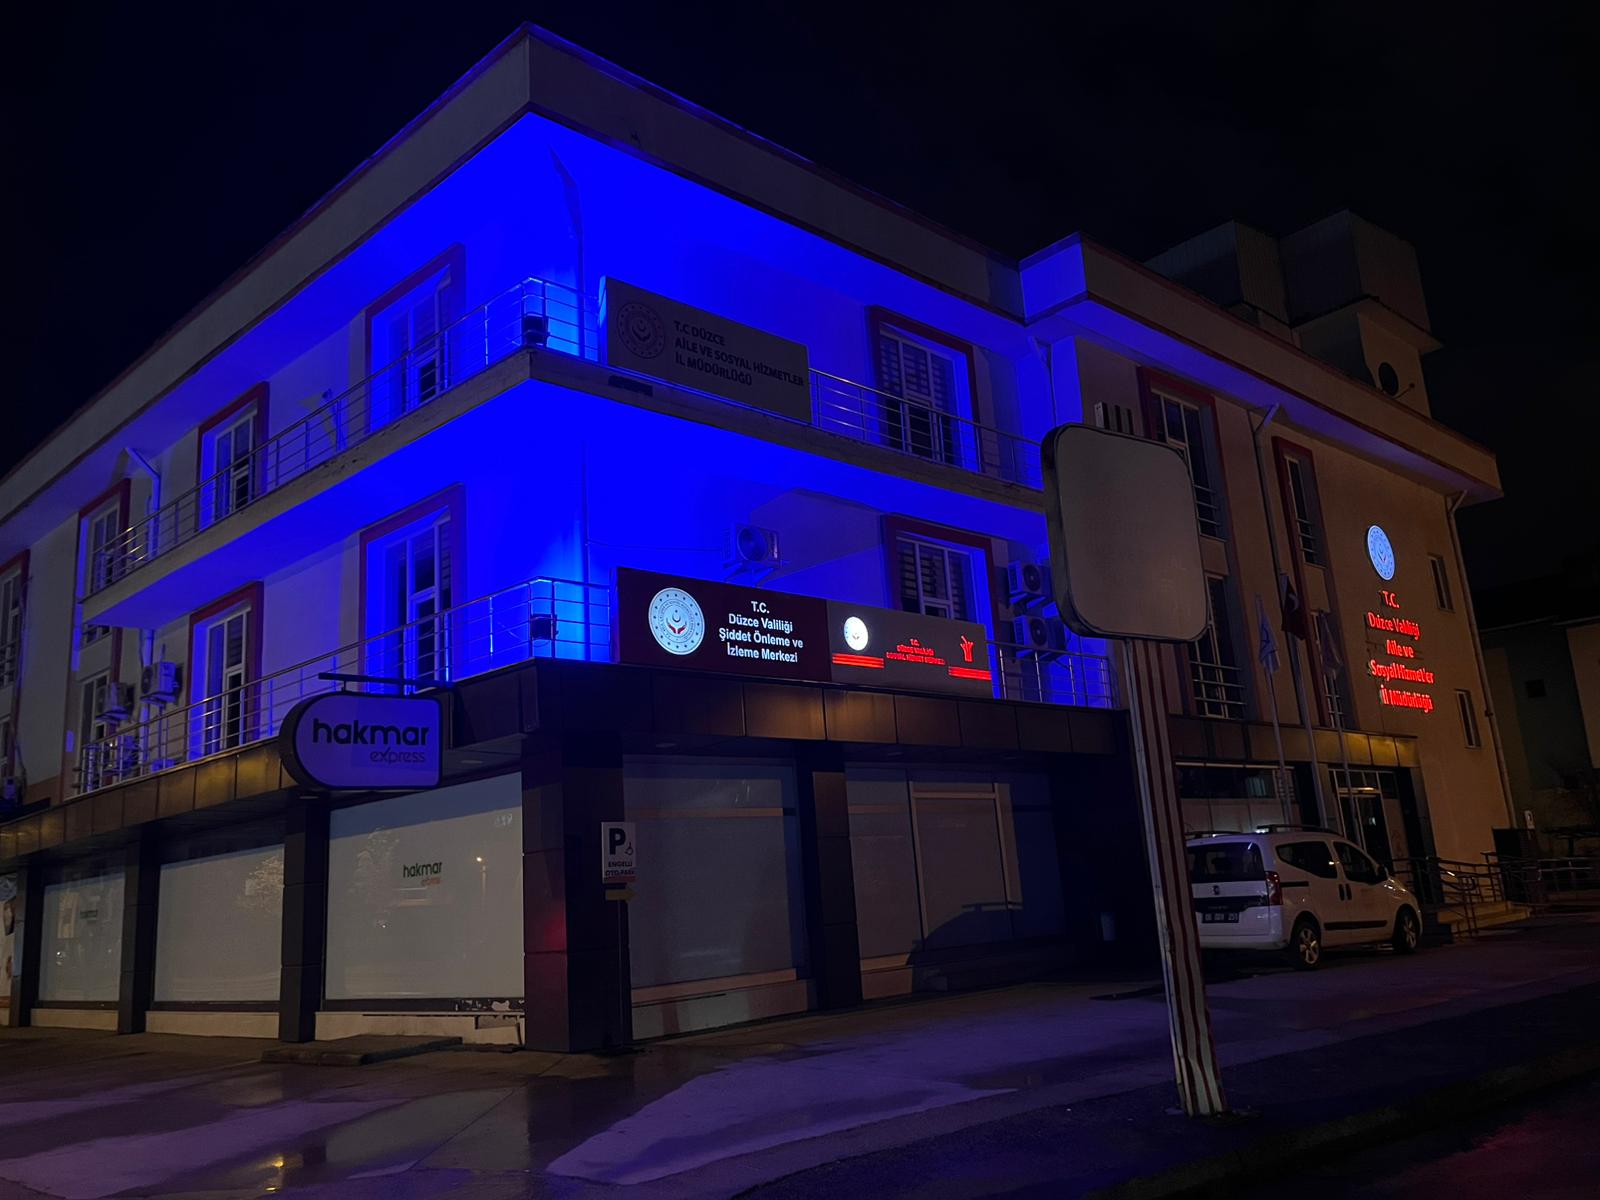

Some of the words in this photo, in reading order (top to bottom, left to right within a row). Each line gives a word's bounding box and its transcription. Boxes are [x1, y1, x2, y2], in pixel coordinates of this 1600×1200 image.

[691, 327, 725, 346] DÜZCE
[675, 337, 699, 354] AİLE
[699, 345, 714, 358] VE
[715, 350, 752, 371] SOSYAL
[753, 361, 805, 386] HİZMETLER
[675, 351, 685, 366] İL
[687, 356, 752, 386] MÜDÜRLÜĞÜ
[750, 600, 770, 614] T.C.
[1382, 590, 1400, 609] T.C.
[728, 613, 759, 628] Düzce
[760, 617, 793, 634] Valiliği
[1367, 611, 1394, 632] Düzce
[1392, 617, 1420, 641] Valiliği
[718, 627, 752, 642] Şiddet
[753, 630, 791, 648] Önleme
[792, 638, 804, 649] ve
[727, 642, 760, 659] İzleme
[761, 648, 798, 663] Merkezi
[1402, 645, 1414, 658] ve
[1370, 659, 1397, 682] Sosyal
[312, 718, 430, 745] hakmar
[369, 747, 425, 763] express
[609, 828, 626, 855] P
[402, 862, 442, 878] hakmar
